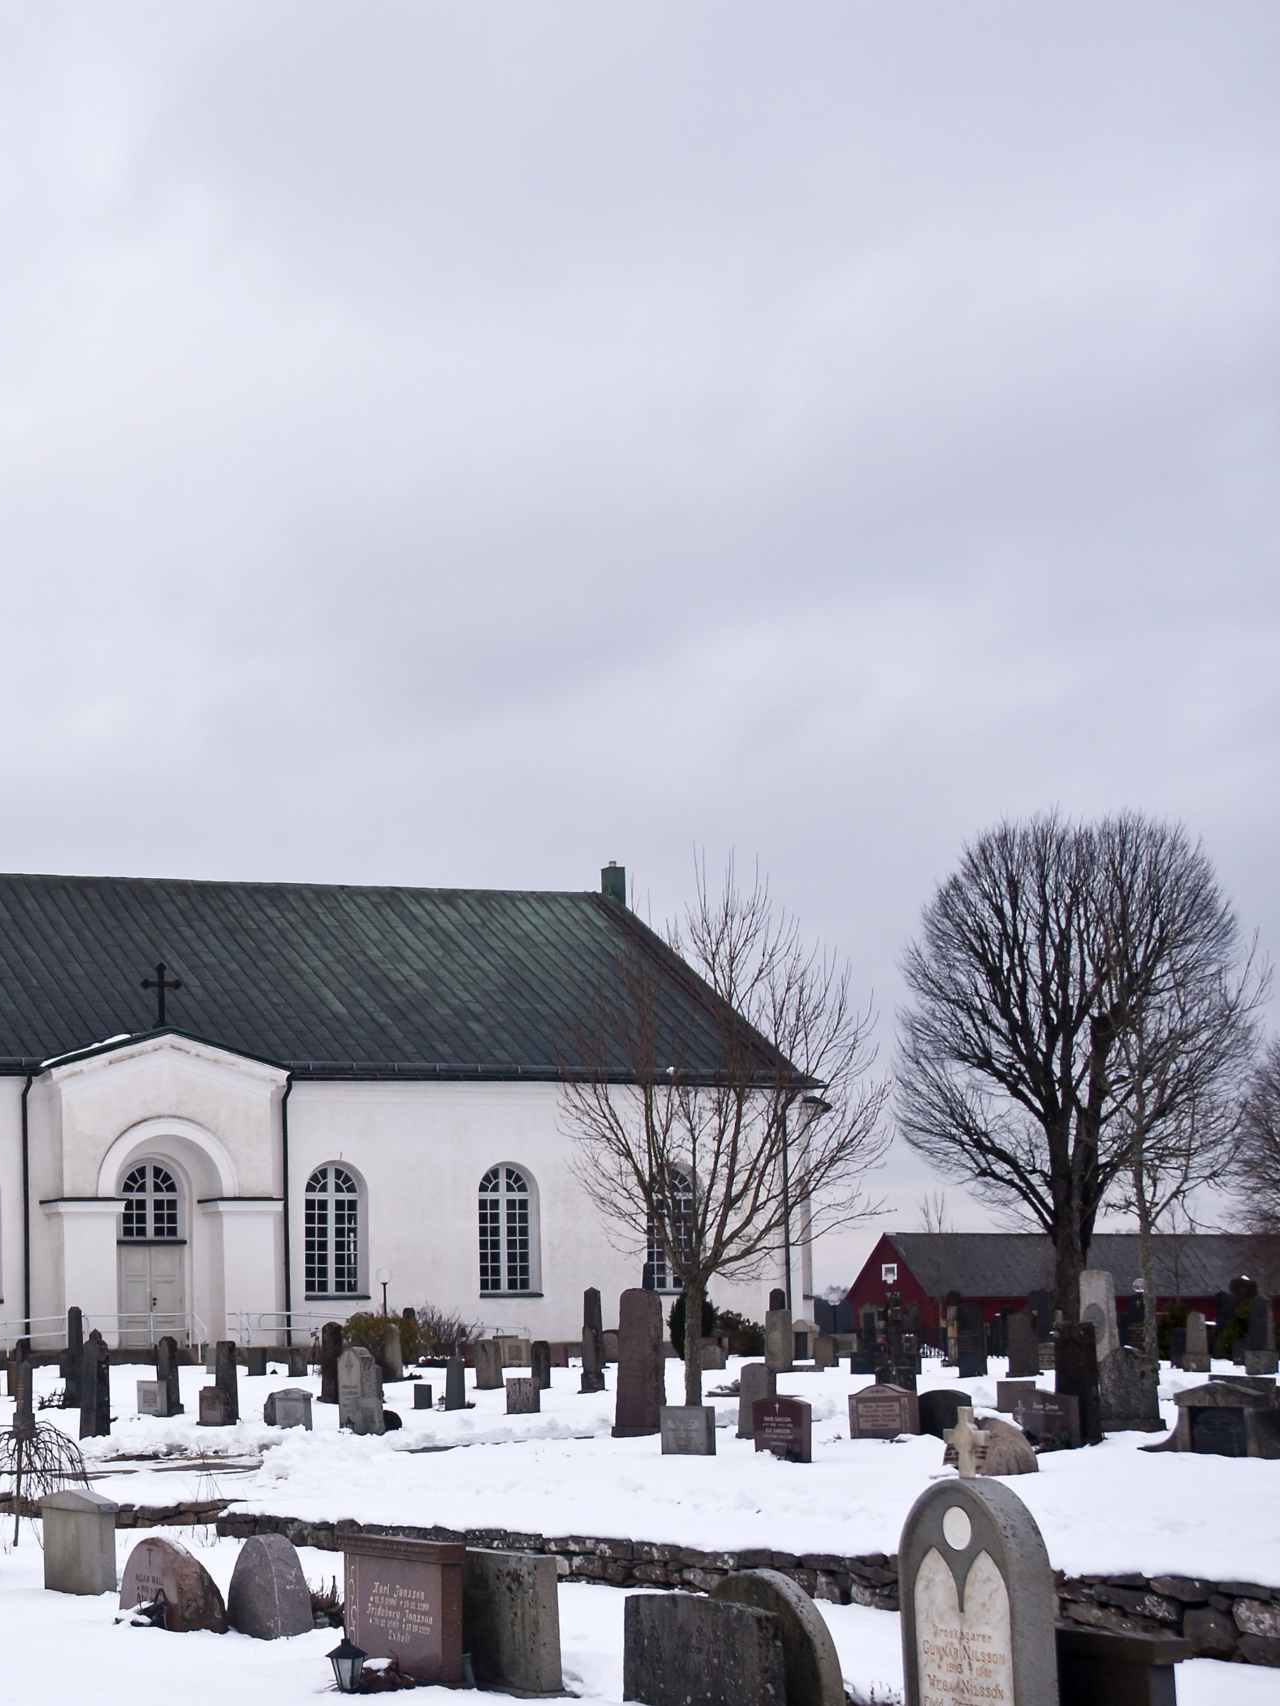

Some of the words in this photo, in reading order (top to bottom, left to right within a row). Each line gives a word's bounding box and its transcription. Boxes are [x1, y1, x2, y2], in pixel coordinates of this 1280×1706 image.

[151, 1576, 164, 1586] WALL
[373, 1581, 390, 1595] Karl
[923, 1639, 958, 1660] GUNNAR
[961, 1645, 1005, 1665] NILSSON
[927, 1674, 955, 1692] WEGA
[961, 1679, 1004, 1700] NILSSON
